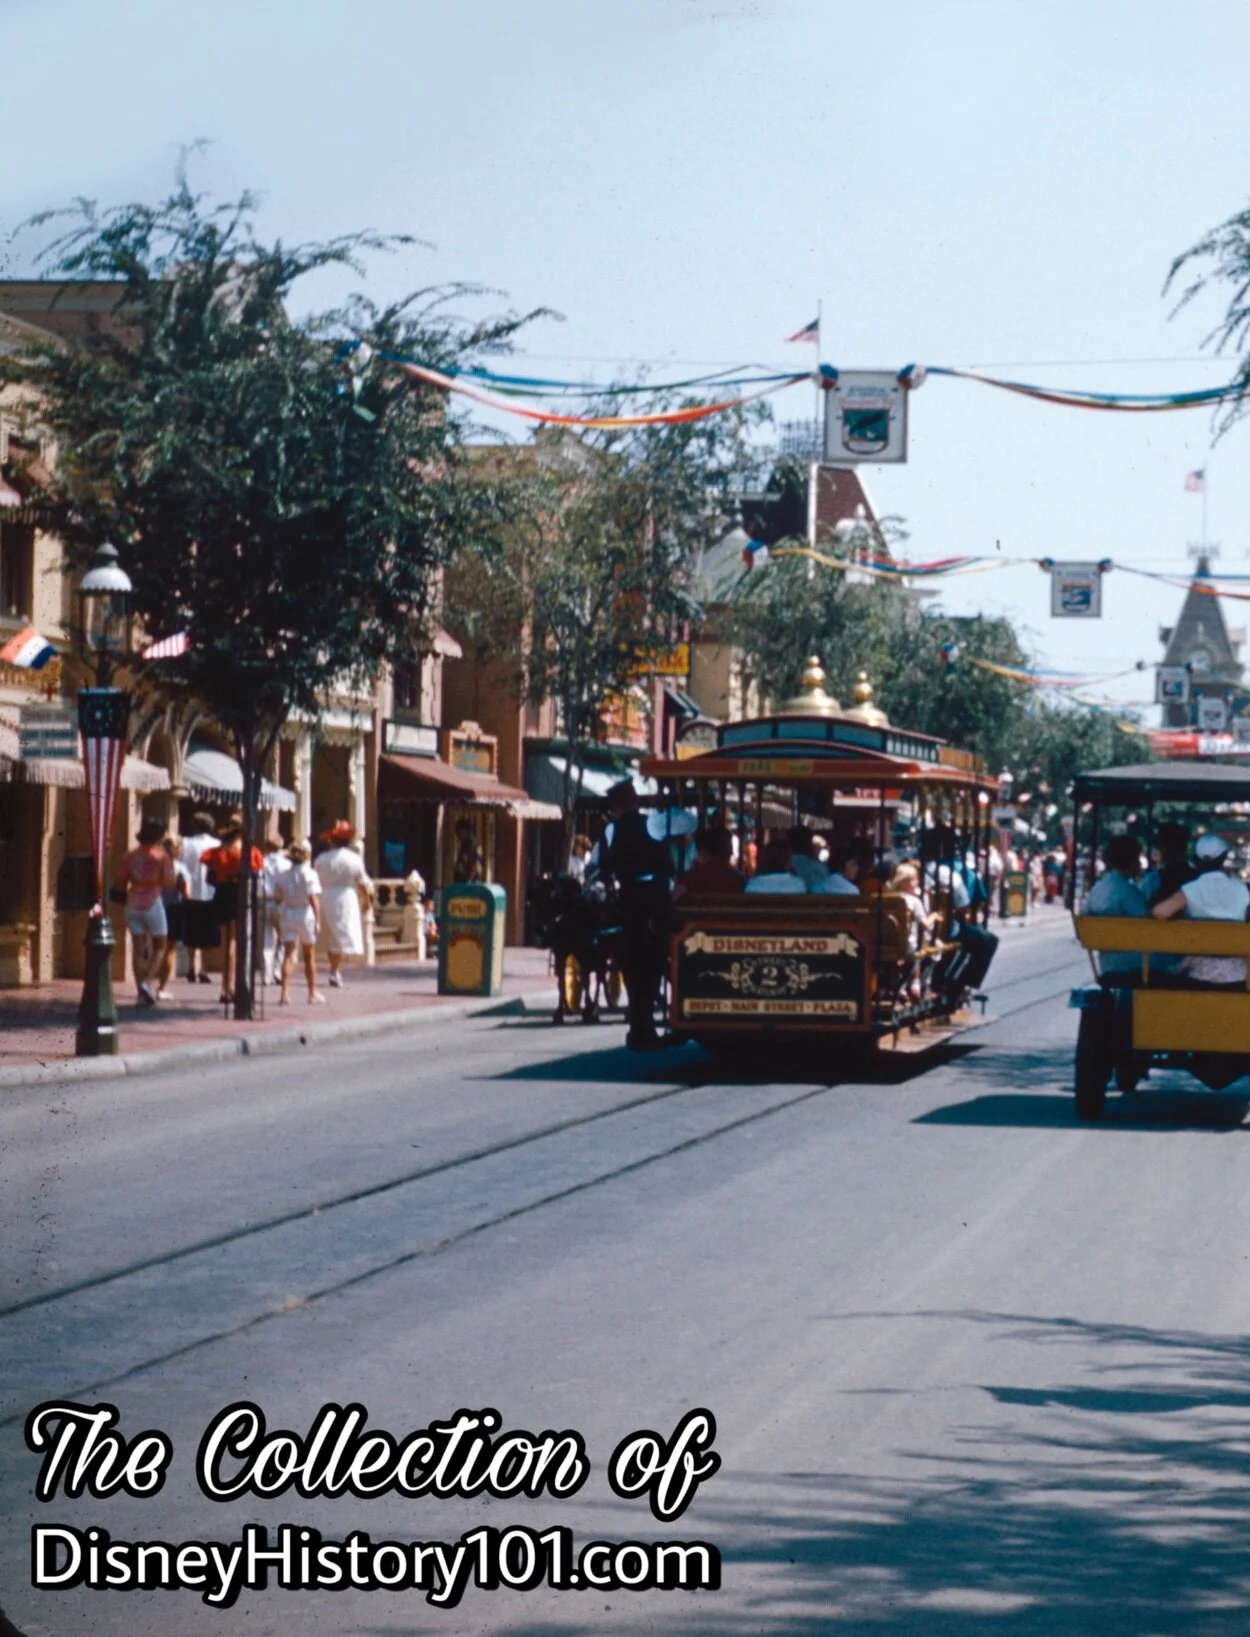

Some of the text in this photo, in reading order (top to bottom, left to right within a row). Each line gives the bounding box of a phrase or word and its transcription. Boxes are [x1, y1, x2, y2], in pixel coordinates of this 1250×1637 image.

[713, 939, 828, 951] DISNEYLAND
[761, 966, 778, 987] 2
[731, 1001, 758, 1012] MAIN
[765, 1002, 804, 1013] STREET
[814, 1003, 852, 1014] PLAZA
